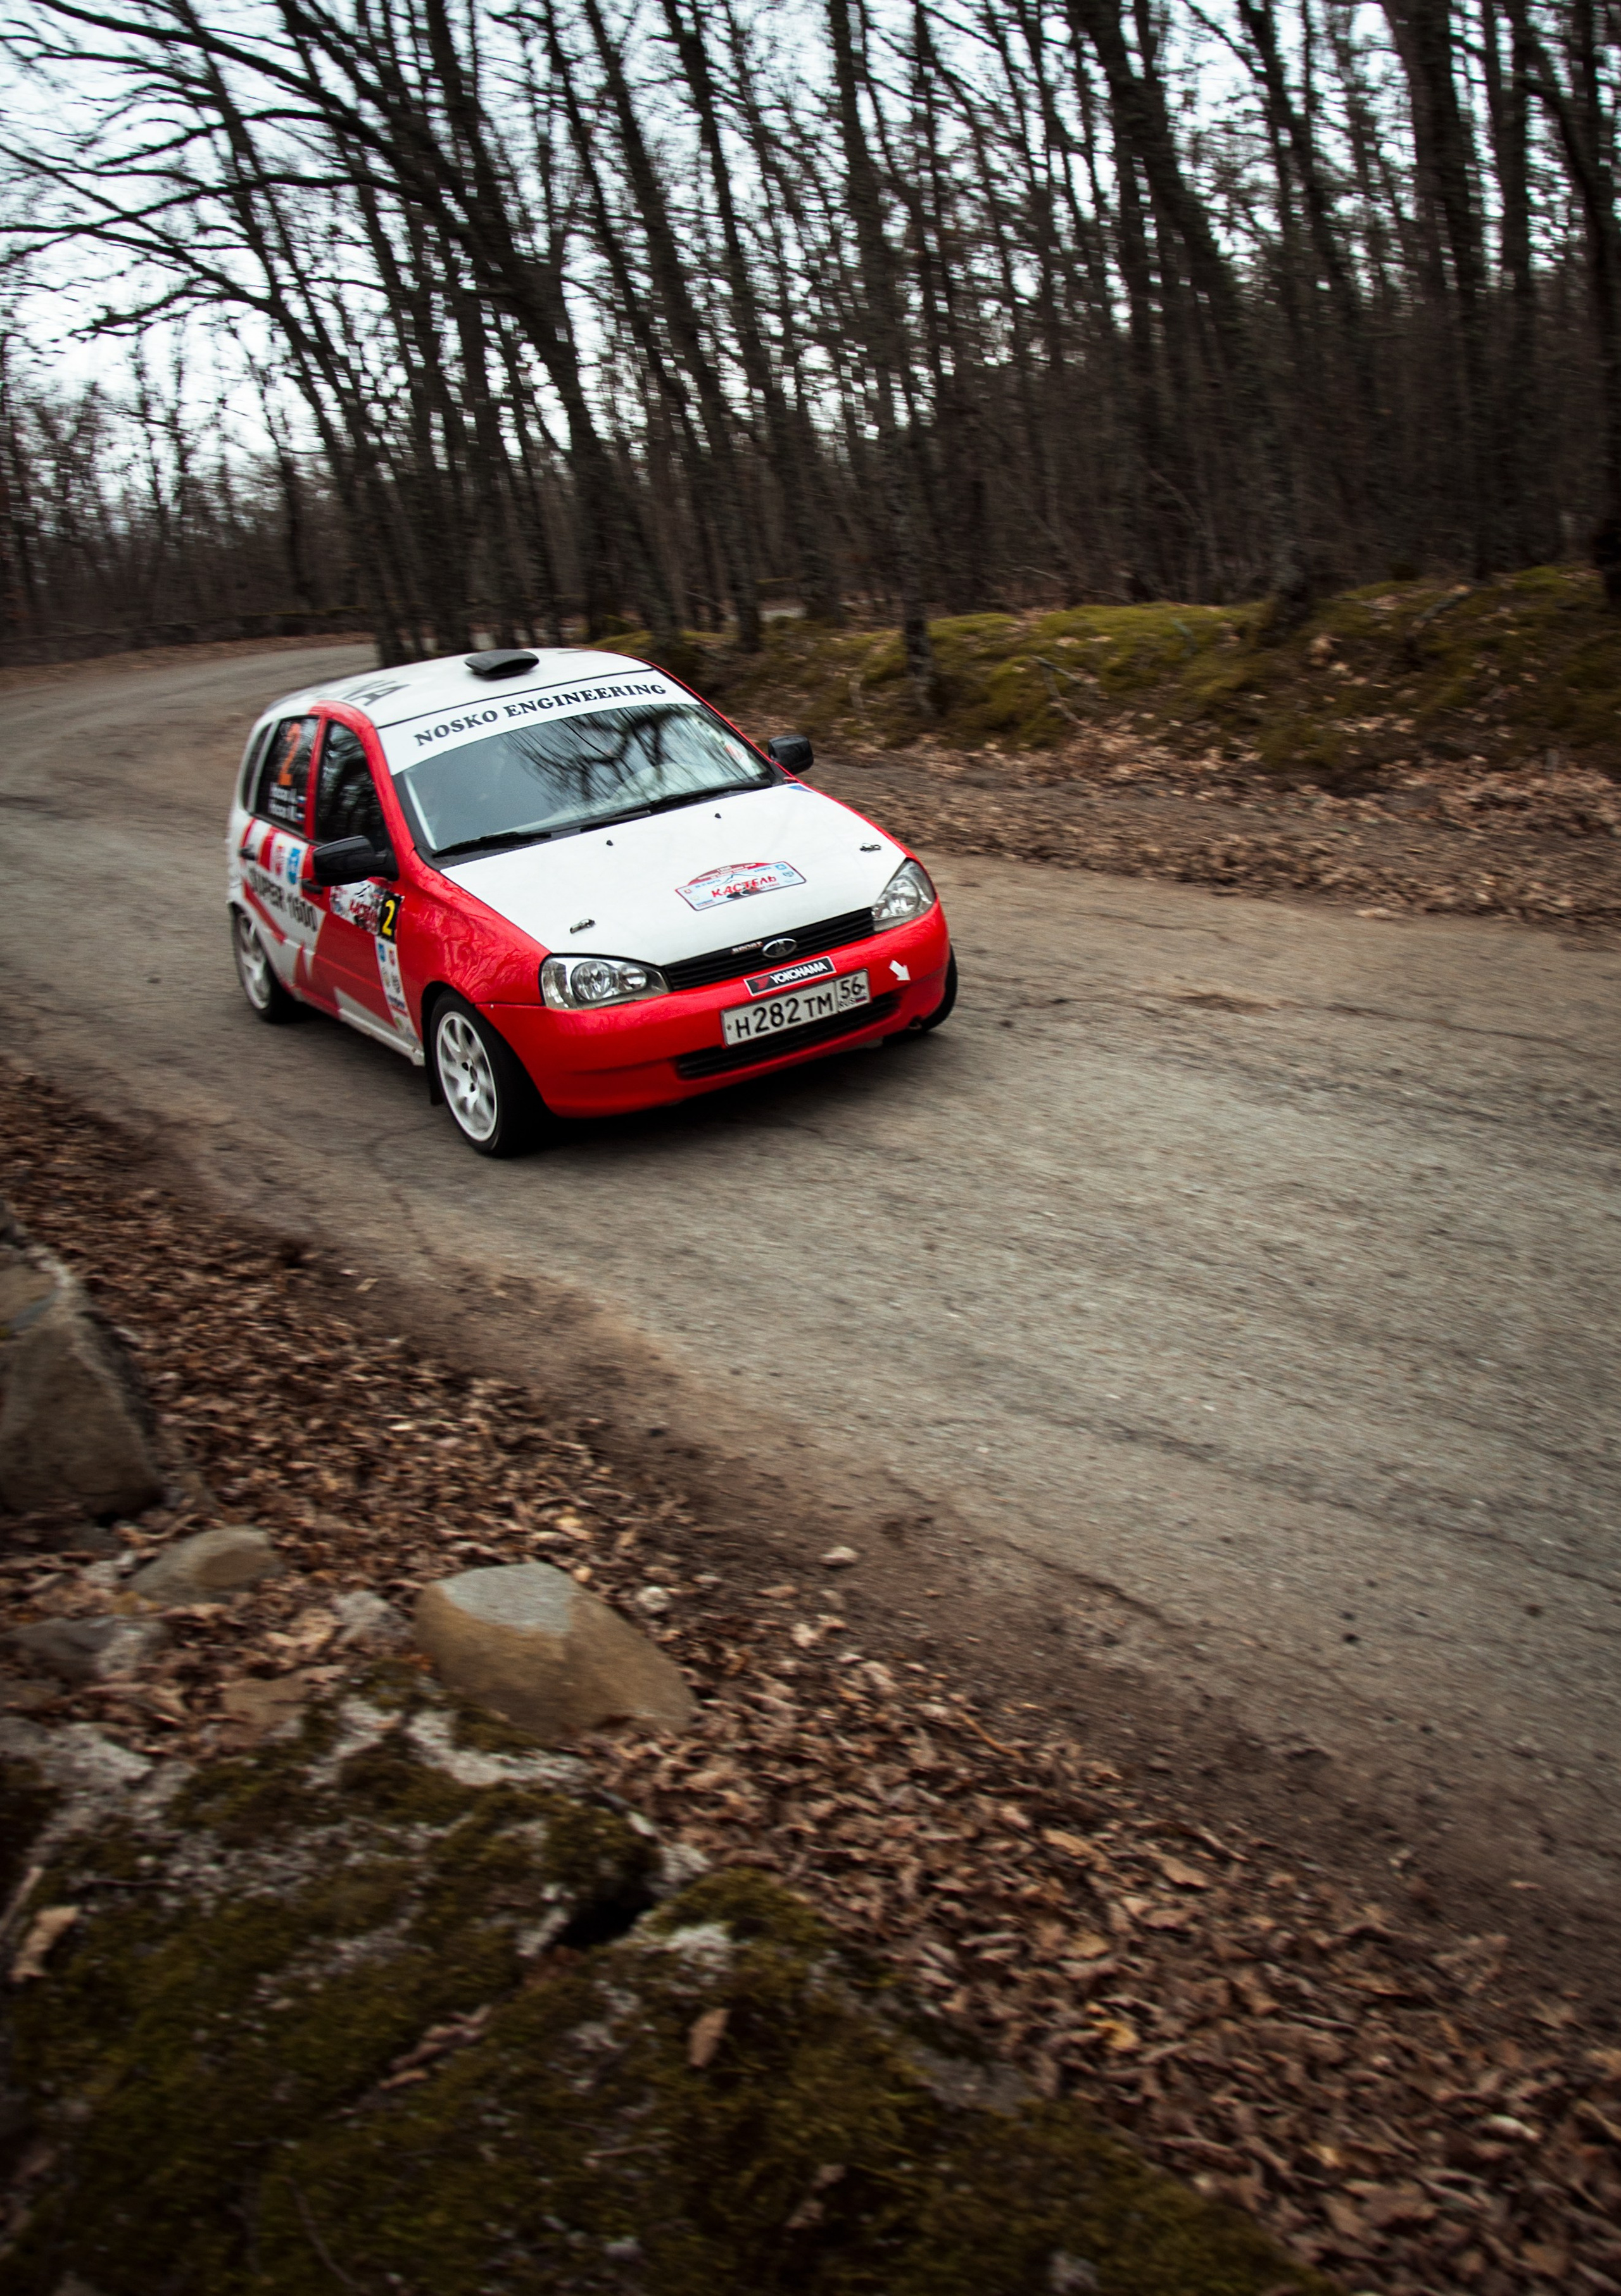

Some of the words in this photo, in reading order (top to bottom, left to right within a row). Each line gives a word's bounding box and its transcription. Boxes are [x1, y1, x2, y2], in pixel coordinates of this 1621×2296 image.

[413, 710, 499, 746] NOSKO
[503, 684, 667, 718] ENGINEERING
[277, 722, 301, 786] 2
[248, 867, 287, 913] SUPER
[287, 892, 318, 933] 1600
[710, 875, 776, 898] КАСТЕЛЬ
[382, 899, 395, 936] 2
[769, 962, 828, 984] YOKOHAMA
[840, 975, 862, 1000] 56
